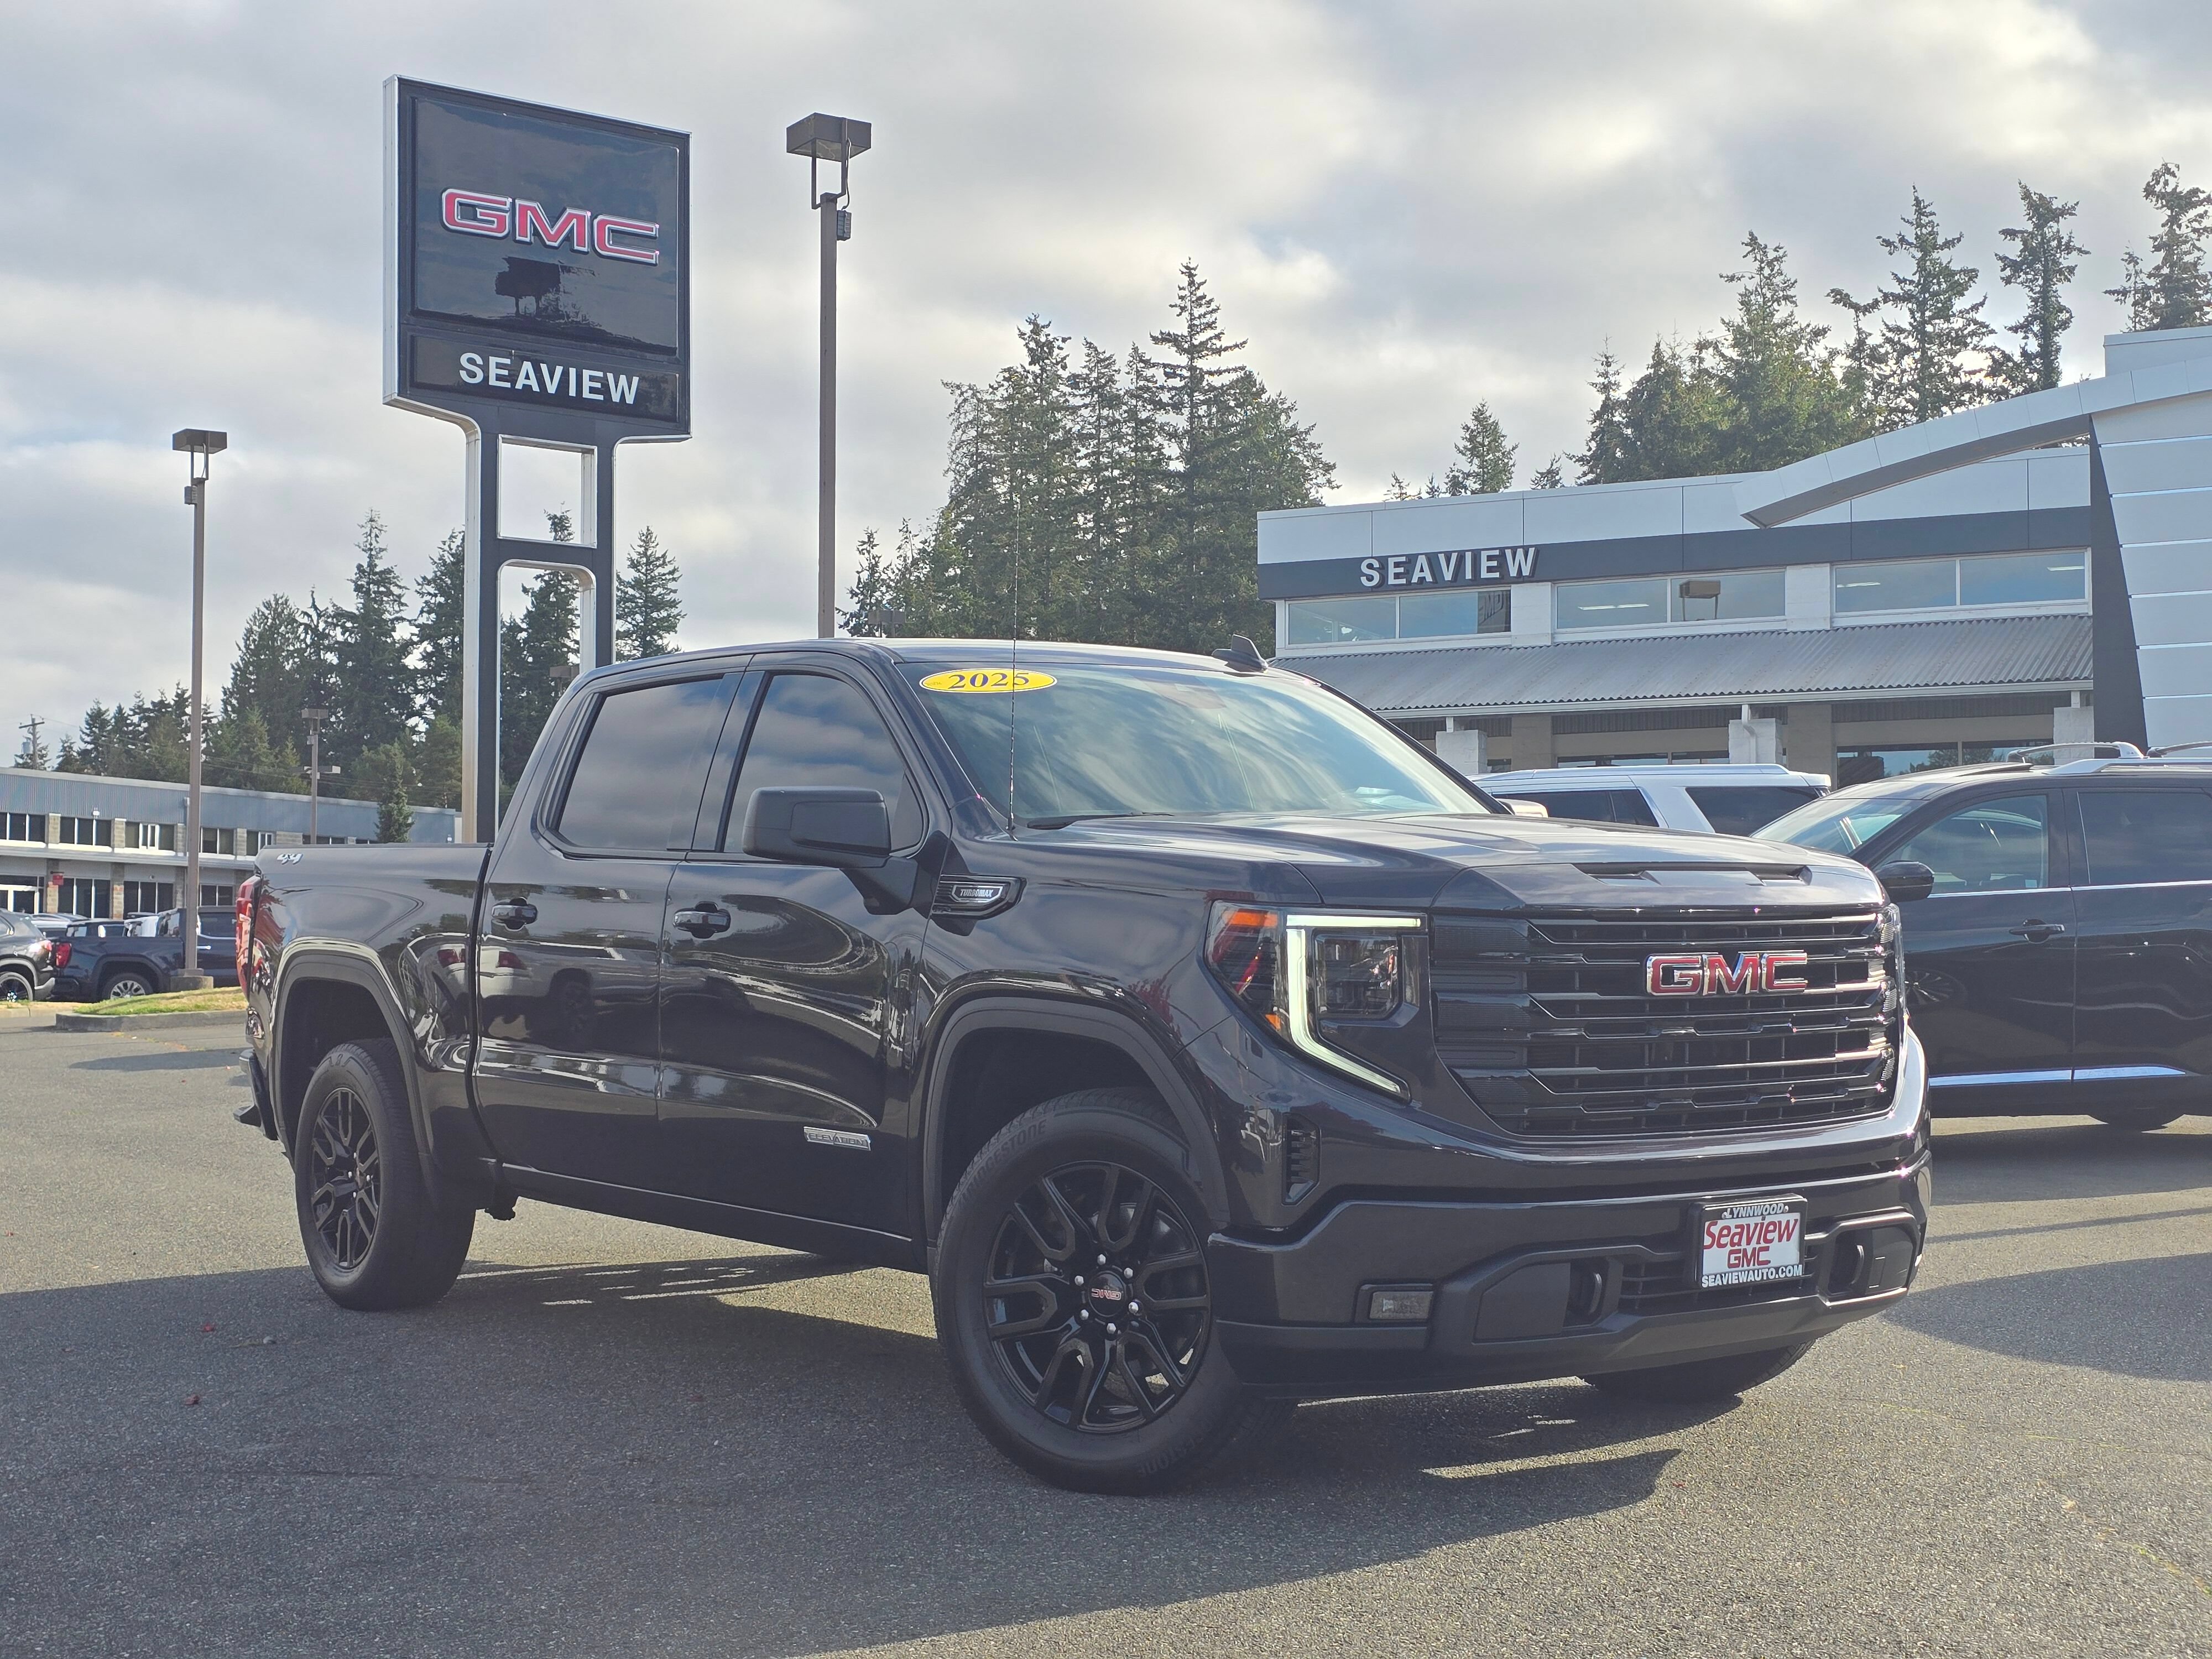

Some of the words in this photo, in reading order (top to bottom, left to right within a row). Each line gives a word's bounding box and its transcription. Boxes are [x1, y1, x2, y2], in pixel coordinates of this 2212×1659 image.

[442, 189, 659, 265] GMC
[459, 352, 639, 404] SEAVIEW
[1360, 547, 1537, 587] SEAVIEW
[948, 672, 1029, 689] 2025
[959, 889, 993, 897] TURBOMAX
[1646, 952, 1807, 996] GMC
[808, 1132, 867, 1147] ELEVATION
[1726, 1203, 1784, 1218] LYNNWOOD
[1704, 1216, 1798, 1250] Seaview
[1728, 1246, 1771, 1269] GMC
[1702, 1265, 1803, 1287] SEAVIEWAUTO.COM
[1091, 1288, 1122, 1300] GMC
